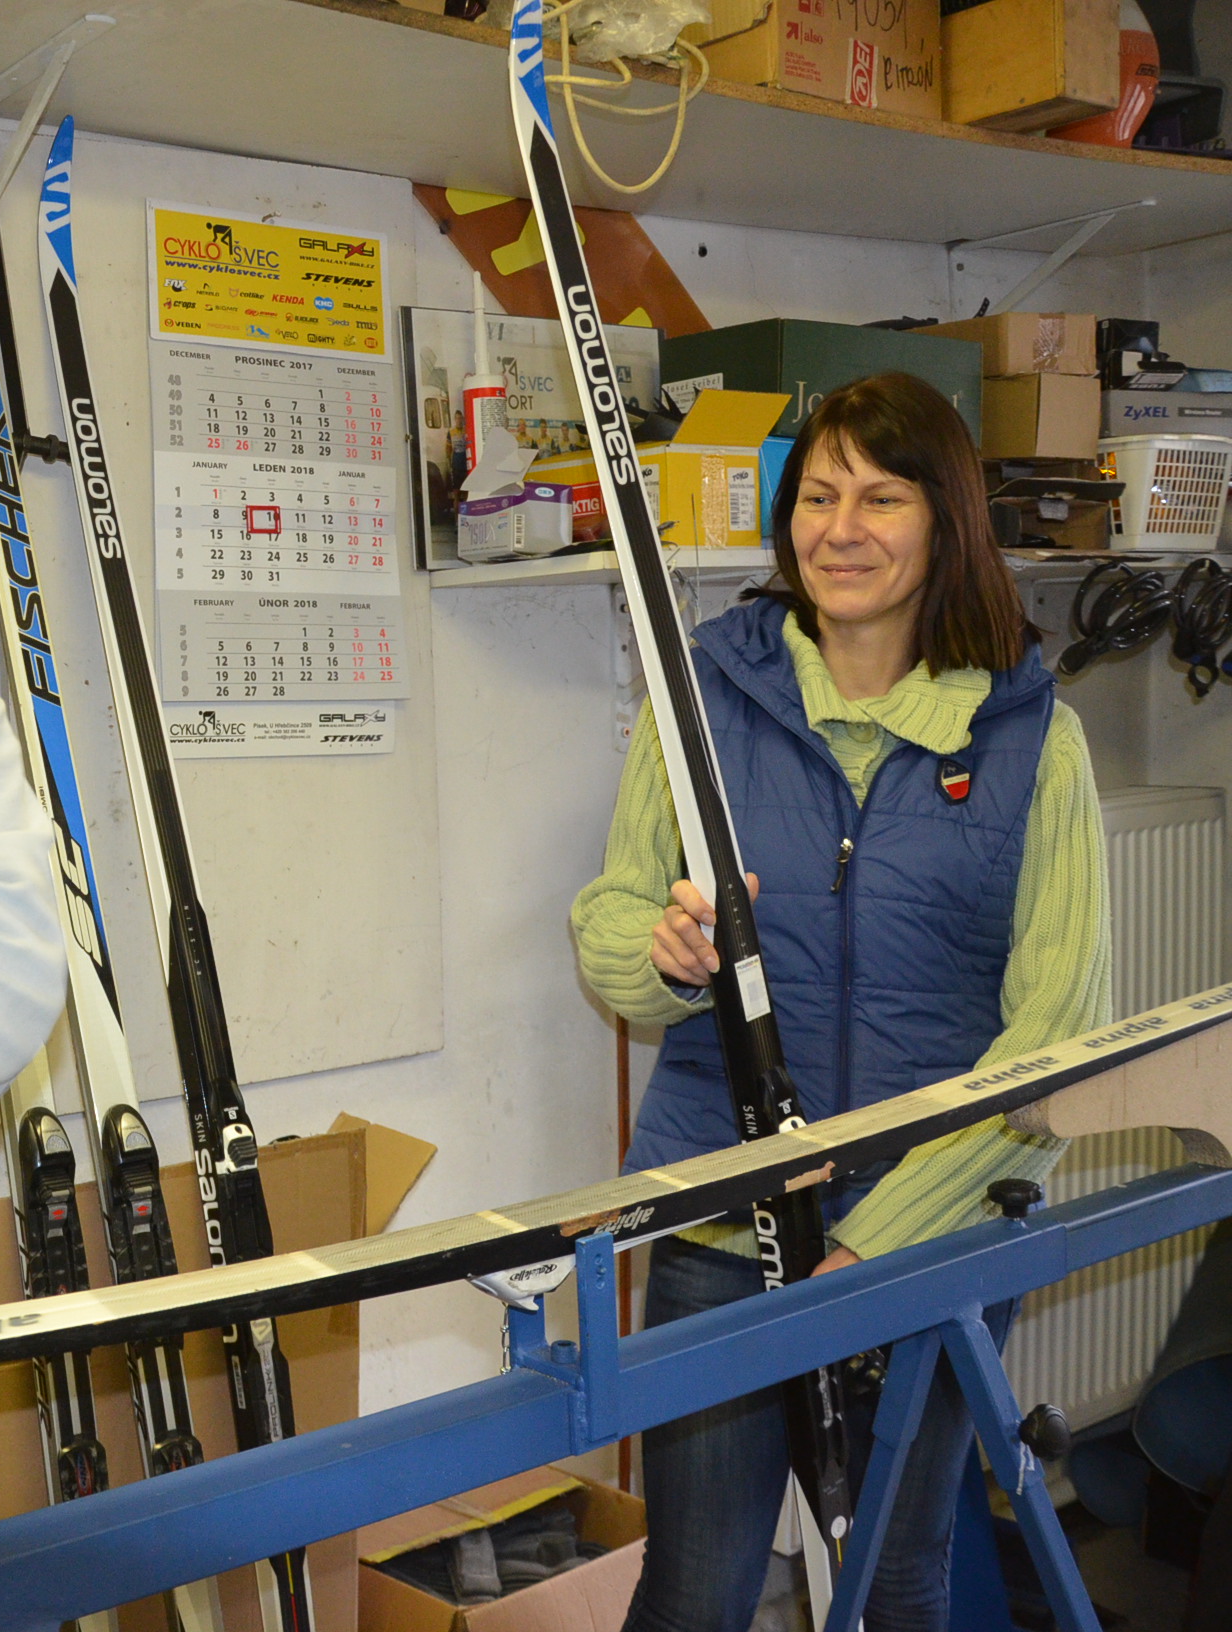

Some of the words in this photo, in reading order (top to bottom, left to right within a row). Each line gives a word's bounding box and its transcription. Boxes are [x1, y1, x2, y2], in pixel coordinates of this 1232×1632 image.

[804, 28, 824, 44] also
[163, 237, 221, 260] CYKLO
[234, 241, 279, 268] ŠVEC
[299, 237, 374, 259] GALAXY
[165, 259, 280, 280] www.cyklosvec.cz
[301, 272, 375, 288] STEVENS
[272, 294, 305, 305] KENDA
[169, 350, 211, 360] DECEMBER
[235, 355, 286, 368] PROSINEC
[289, 361, 313, 371] 2017
[337, 367, 376, 377] DEZEMBER
[318, 389, 323, 399] 1
[371, 394, 378, 404] 3
[209, 393, 215, 403] 4
[237, 396, 243, 406] 5
[265, 398, 271, 408] 6
[292, 401, 297, 411] 7
[319, 403, 326, 413] 8
[370, 407, 381, 418] 10
[1124, 406, 1170, 420] ZyXEL
[206, 408, 218, 418] 11
[235, 410, 247, 421] 12
[263, 413, 275, 423] 13
[290, 415, 302, 426] 14
[318, 417, 330, 427] 15
[370, 422, 382, 432] 17
[207, 423, 220, 433] 18
[236, 425, 248, 435] 19
[264, 427, 276, 438] 20
[291, 429, 302, 440] 21
[318, 431, 330, 442] 22
[371, 436, 382, 446] 24
[207, 437, 221, 449] 25
[236, 440, 249, 451] 26
[264, 442, 276, 452] 27
[292, 444, 304, 454] 28
[319, 446, 331, 456] 29
[371, 450, 382, 461] 31
[192, 461, 228, 470] JANUARY
[253, 463, 286, 473] LEDEN
[290, 465, 315, 475] 2018
[338, 470, 366, 479] JANUAR
[213, 488, 218, 499] 1
[241, 490, 247, 500] 2
[269, 492, 275, 502] 3
[297, 493, 303, 503] 4
[324, 495, 330, 505] 5
[374, 498, 380, 509] 7
[213, 509, 219, 519] 8
[295, 513, 306, 523] 11
[322, 514, 333, 525] 12
[372, 518, 383, 528] 14
[210, 529, 223, 539] 15
[296, 532, 308, 543] 18
[322, 534, 334, 544] 19
[372, 537, 382, 547] 21
[210, 549, 224, 560] 22
[240, 550, 252, 561] 23
[268, 551, 280, 561] 24
[296, 552, 308, 562] 25
[323, 553, 335, 564] 26
[372, 556, 384, 566] 28
[211, 569, 225, 580] 29
[241, 570, 253, 581] 30
[268, 571, 280, 581] 31
[193, 599, 235, 607] FEBRUARY
[258, 597, 289, 608] ÚNOR
[293, 599, 318, 609] 2018
[340, 602, 371, 610] FEBRUAR
[302, 627, 307, 637] 1
[328, 627, 334, 638] 2
[379, 628, 386, 638] 4
[218, 641, 224, 651] 5
[246, 641, 252, 652] 6
[274, 641, 280, 652] 7
[302, 641, 309, 652] 8
[329, 642, 335, 652] 9
[378, 642, 389, 652] 11
[216, 656, 228, 666] 12
[244, 656, 256, 666] 13
[272, 656, 284, 666] 14
[300, 656, 312, 667] 15
[327, 656, 338, 667] 16
[379, 656, 392, 667] 18
[216, 671, 228, 681] 19
[244, 671, 257, 681] 20
[272, 671, 283, 681] 21
[300, 671, 312, 681] 22
[327, 671, 339, 681] 23
[380, 671, 393, 681] 25
[216, 686, 229, 697] 26
[245, 686, 257, 696] 27
[273, 686, 285, 696] 28
[319, 710, 385, 726] GALAXY
[169, 723, 208, 736] CYKLO
[215, 720, 246, 735] ŠVEC
[320, 734, 384, 743] STEVENS
[1083, 1015, 1169, 1050] alpina
[962, 1055, 1061, 1092] alpina
[195, 1113, 207, 1143] SKIN
[742, 1105, 758, 1135] SKIN
